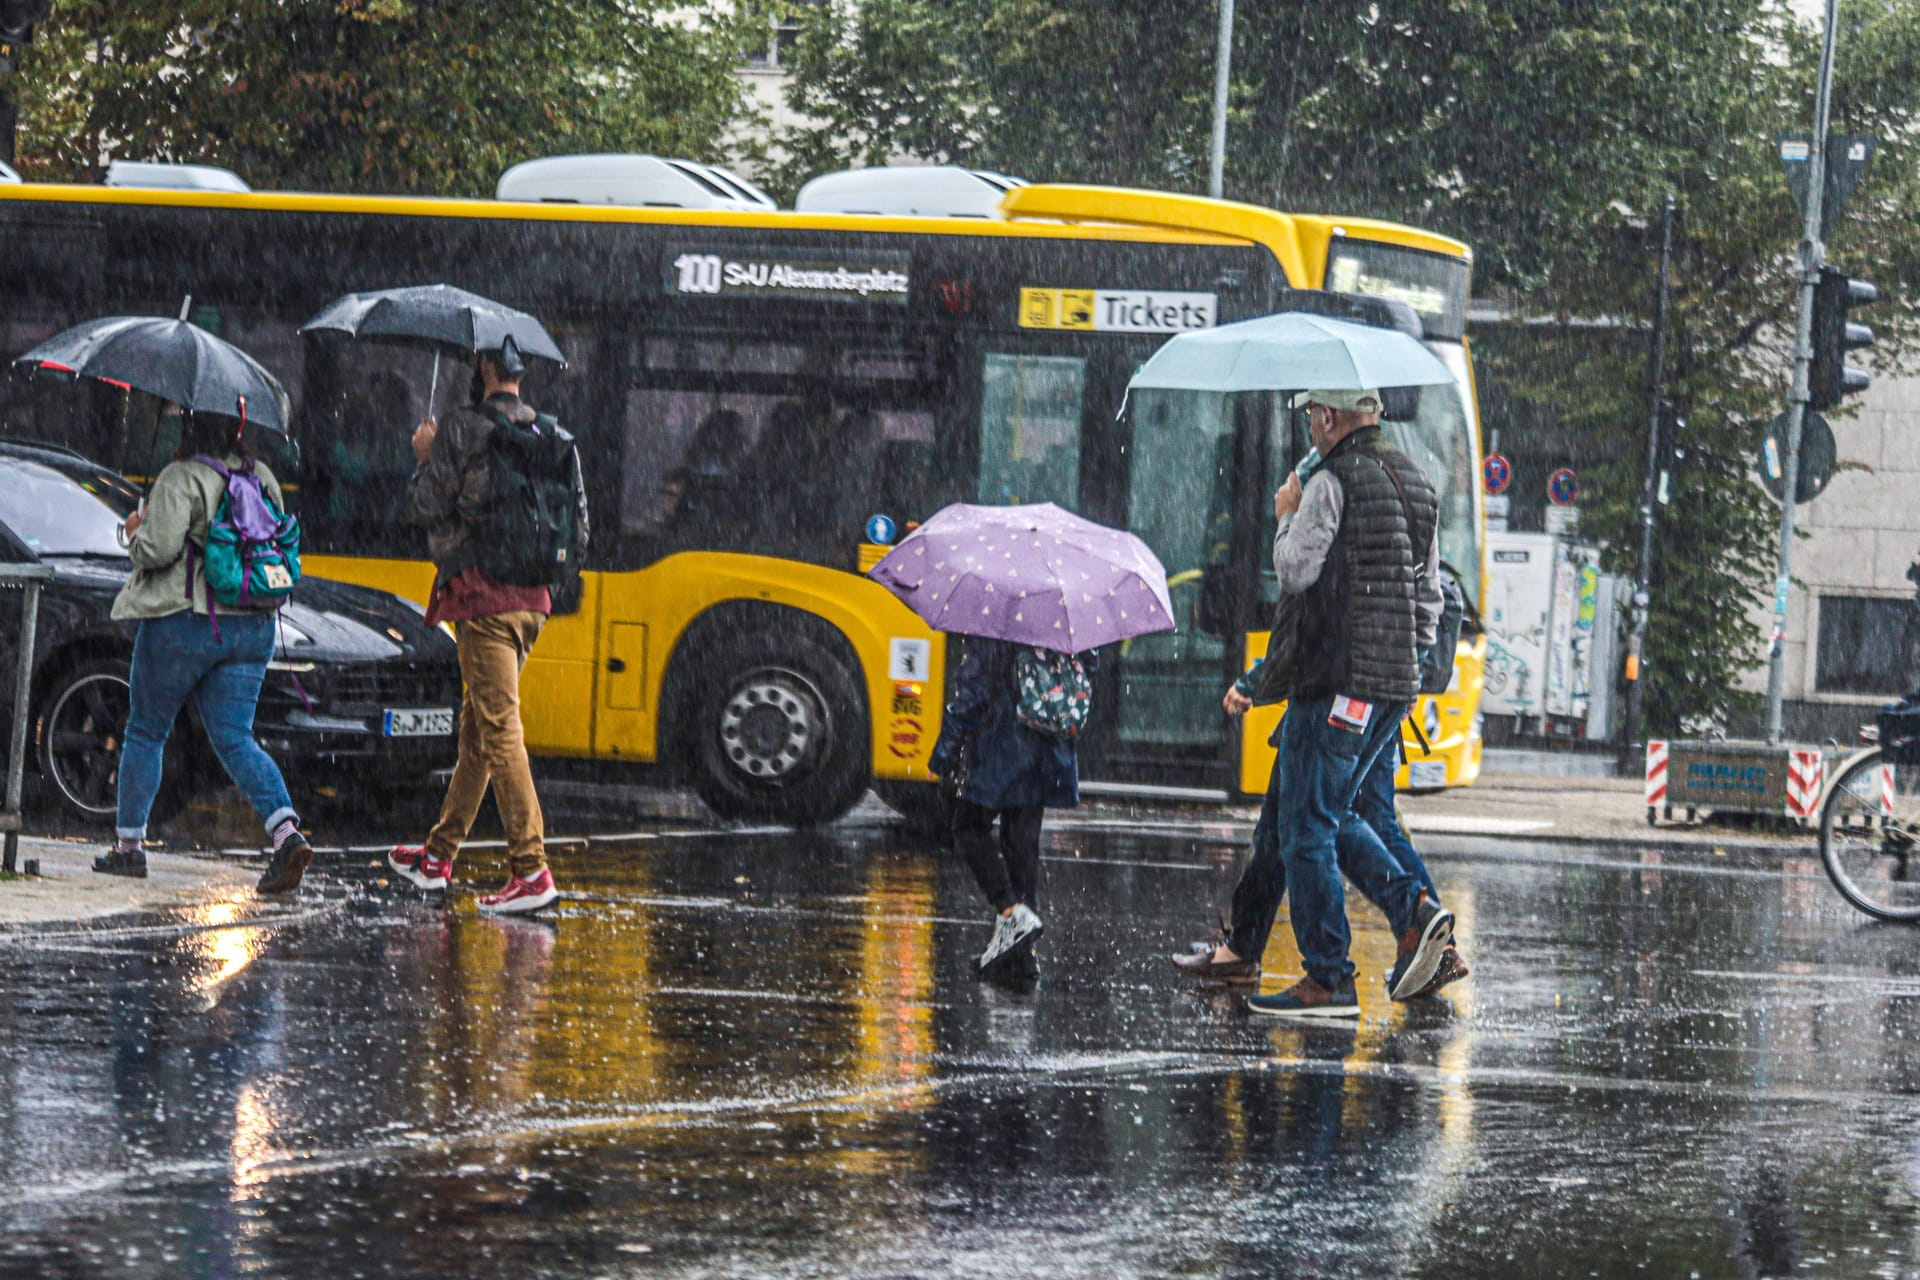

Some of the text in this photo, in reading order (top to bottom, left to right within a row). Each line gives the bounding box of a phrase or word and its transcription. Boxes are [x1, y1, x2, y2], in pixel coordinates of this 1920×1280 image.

[674, 254, 721, 294] 100
[767, 264, 908, 296] Alexanderplatz
[1103, 296, 1208, 328] Tickets
